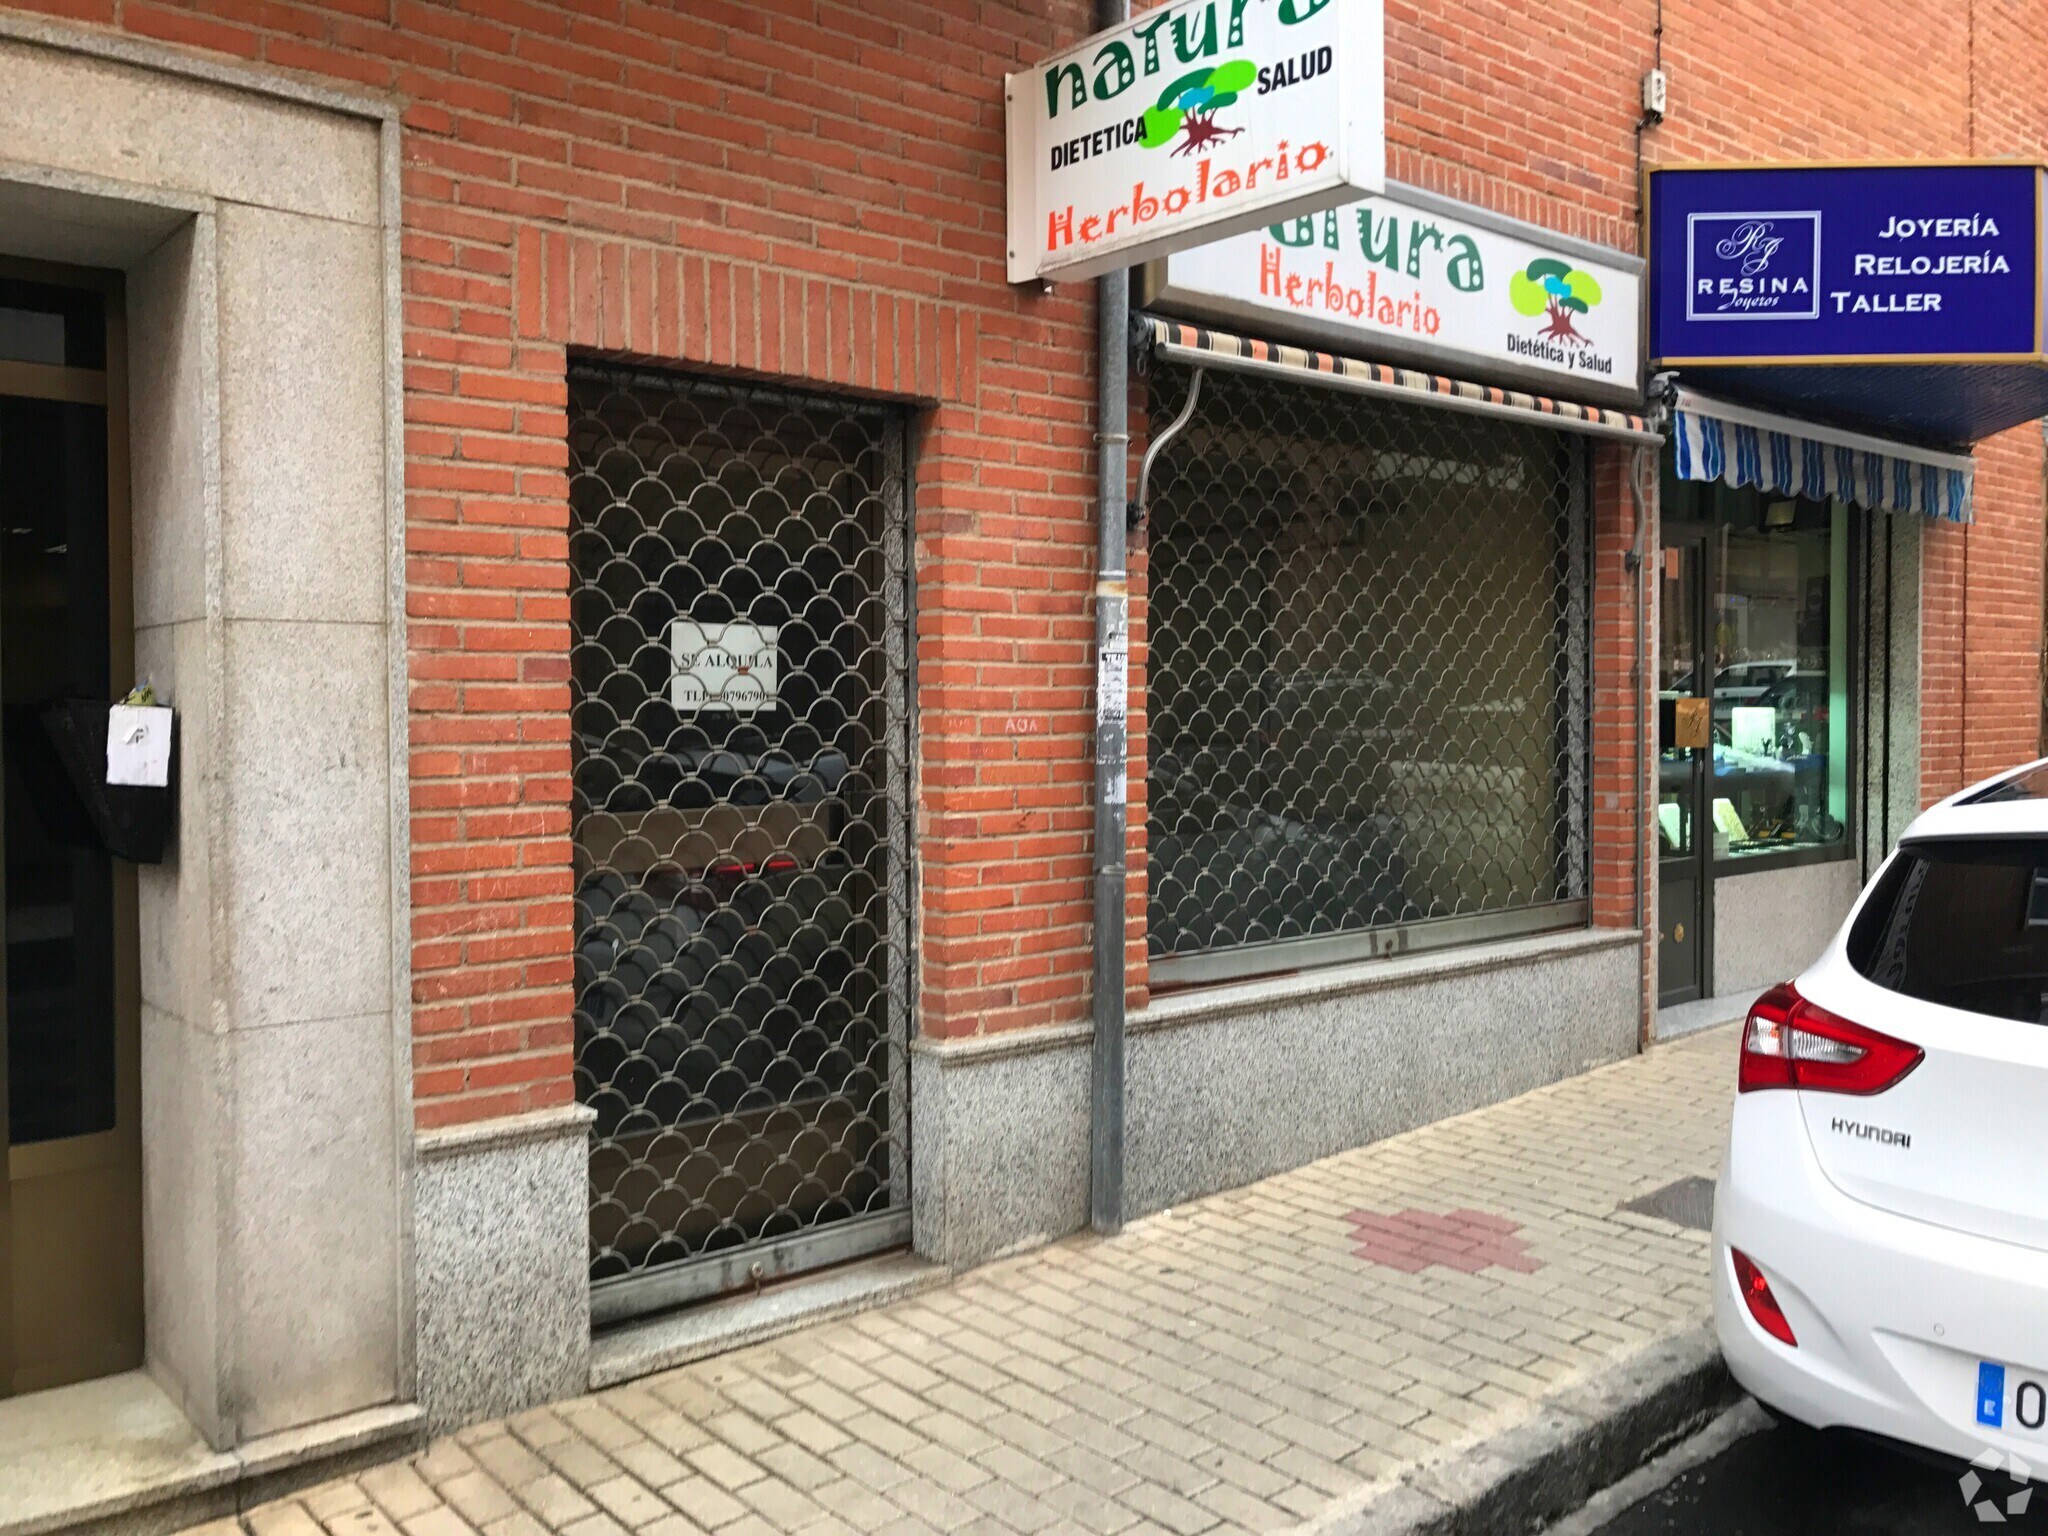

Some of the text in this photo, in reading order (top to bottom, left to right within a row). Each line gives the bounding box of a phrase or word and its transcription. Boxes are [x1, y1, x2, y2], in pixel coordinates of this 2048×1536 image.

[1257, 45, 1332, 95] SALUD
[1051, 115, 1147, 170] DIETETICA
[1047, 139, 1329, 250] Herbolario
[1878, 213, 2000, 242] JOYERÍA
[1269, 207, 1484, 292] tura
[1854, 250, 2010, 275] RELOJERÍA
[1259, 243, 1441, 336] Herbolario
[1697, 277, 1809, 294] RESINA
[1717, 288, 1780, 311] Joyeros
[1830, 291, 1942, 313] TALLER
[1507, 334, 1612, 374] Dietética y Salud
[705, 653, 773, 670] ALQUILA
[1831, 1117, 1911, 1149] HYUNDAI
